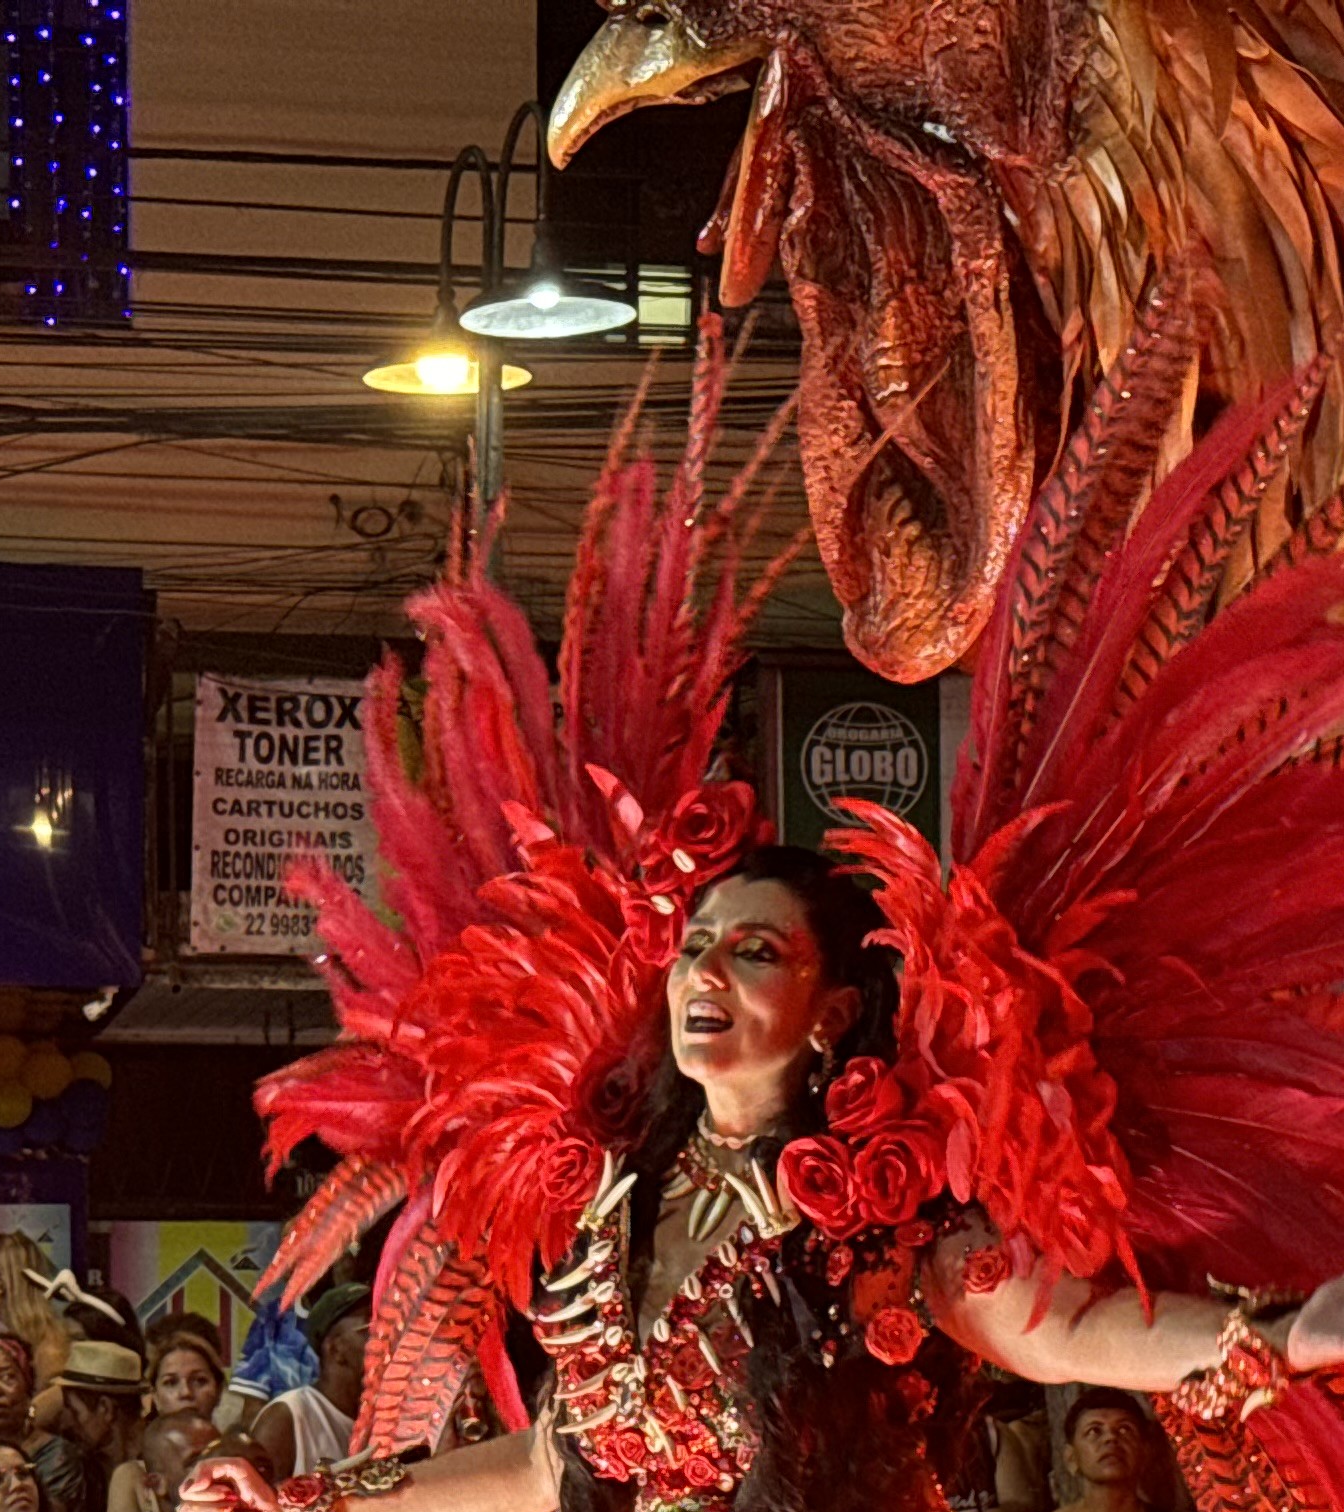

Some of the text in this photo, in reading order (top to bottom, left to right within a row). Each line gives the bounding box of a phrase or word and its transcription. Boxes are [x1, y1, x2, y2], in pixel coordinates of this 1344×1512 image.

[215, 686, 363, 730] XEROX
[233, 730, 345, 767] TONER
[810, 746, 918, 787] GLOBO
[214, 767, 362, 792] RECARGA NA HORA
[211, 798, 365, 821] CARTUCHOS
[224, 828, 353, 849] ORIGINAIS
[245, 912, 318, 937] 22 9983
